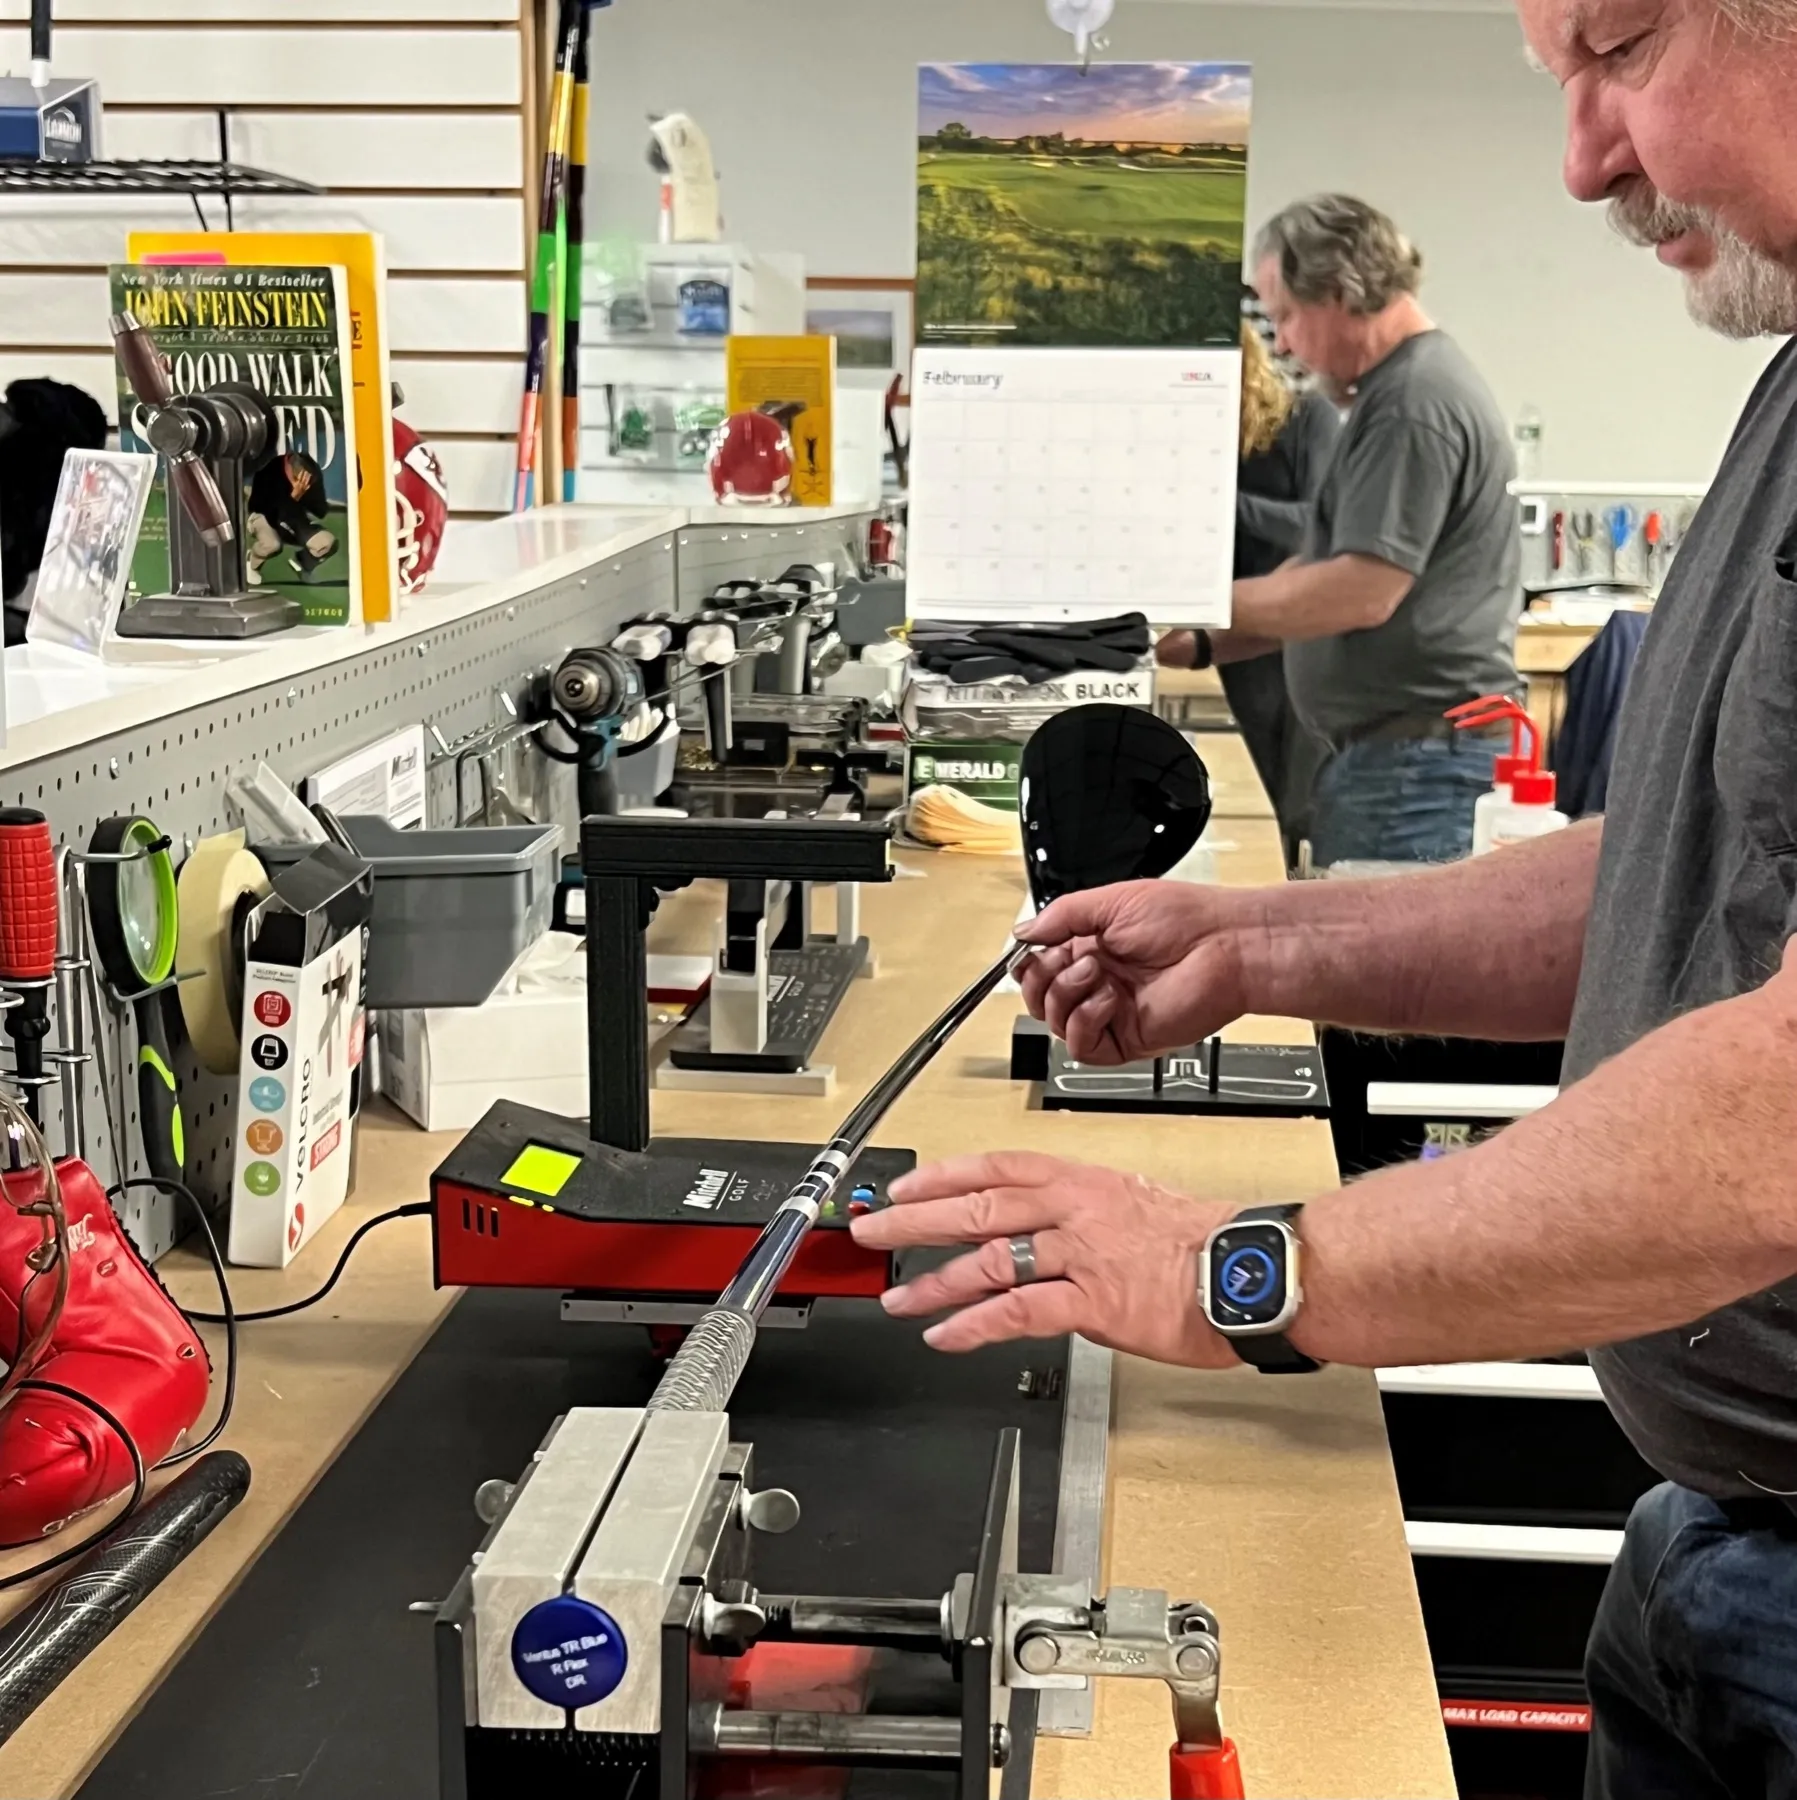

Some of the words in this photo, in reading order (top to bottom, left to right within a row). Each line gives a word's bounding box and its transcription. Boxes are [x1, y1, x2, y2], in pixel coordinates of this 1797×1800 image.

[122, 273, 147, 286] New
[151, 272, 184, 286] York
[189, 272, 228, 286] Times
[258, 273, 326, 288] Bestseller
[125, 290, 189, 327] JOHN
[194, 290, 328, 328] FEINSTEIN
[246, 351, 334, 398] WALK
[922, 370, 1004, 390] February
[1075, 682, 1140, 699] BLACK
[729, 1177, 750, 1202] GOLF
[550, 1662, 564, 1676] R
[1443, 1706, 1478, 1721] MAX
[1479, 1708, 1519, 1723] LOAD
[1519, 1710, 1588, 1725] CAPACITY
